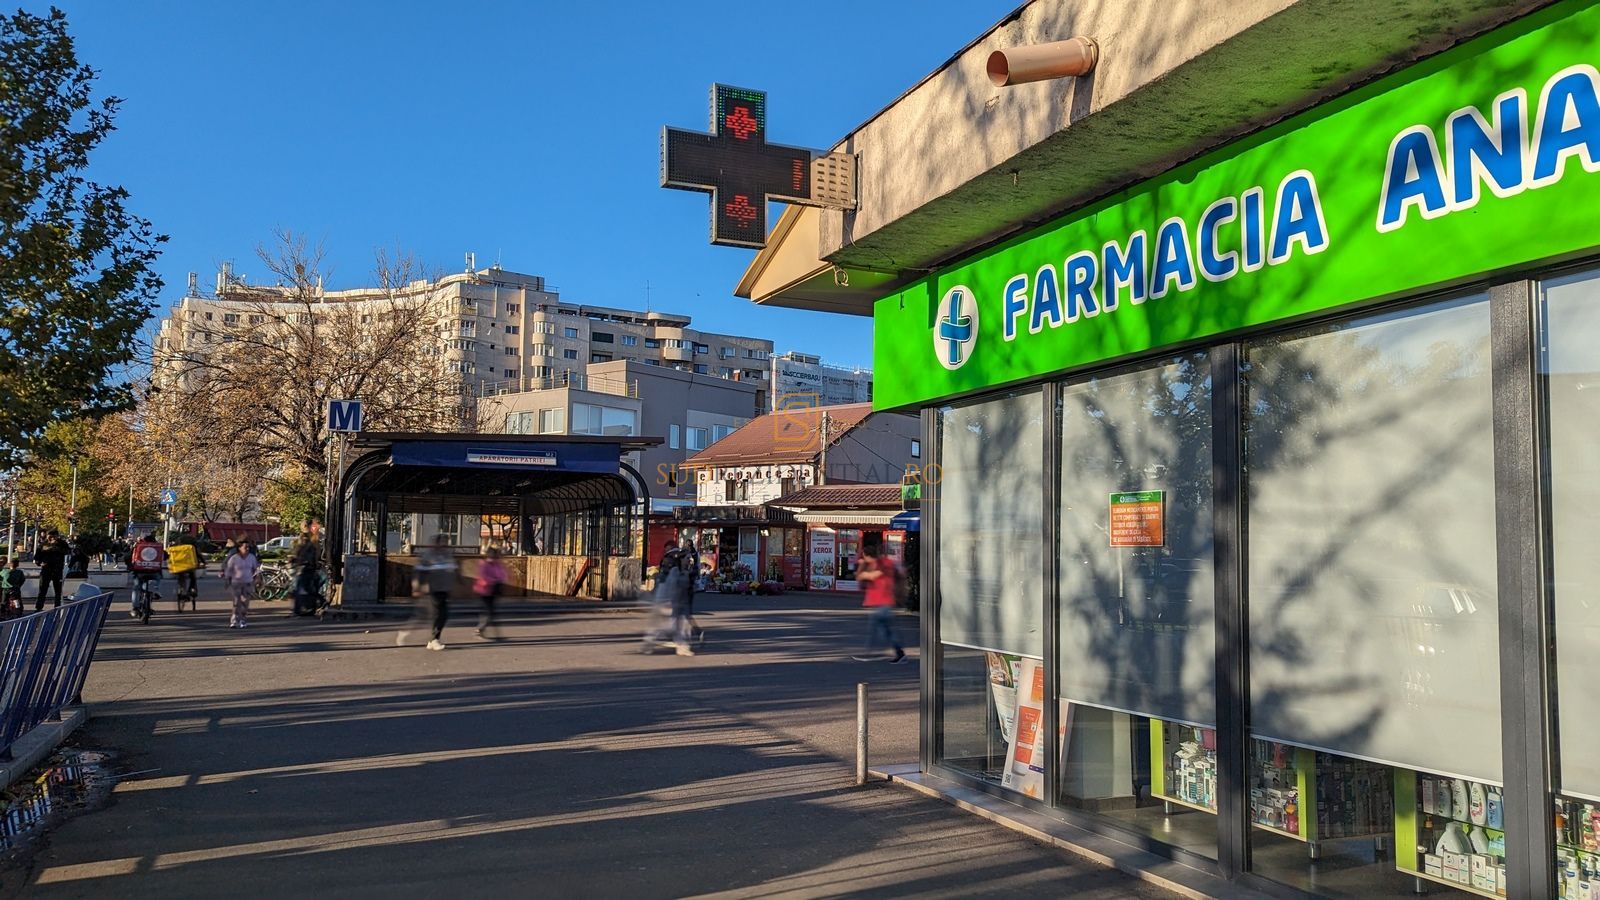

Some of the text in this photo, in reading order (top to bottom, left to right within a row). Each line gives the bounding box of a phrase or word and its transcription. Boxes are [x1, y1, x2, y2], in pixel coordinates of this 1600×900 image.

[1003, 63, 1600, 342] FARMACIA ANA
[328, 400, 361, 431] M
[813, 546, 833, 554] XEROX
